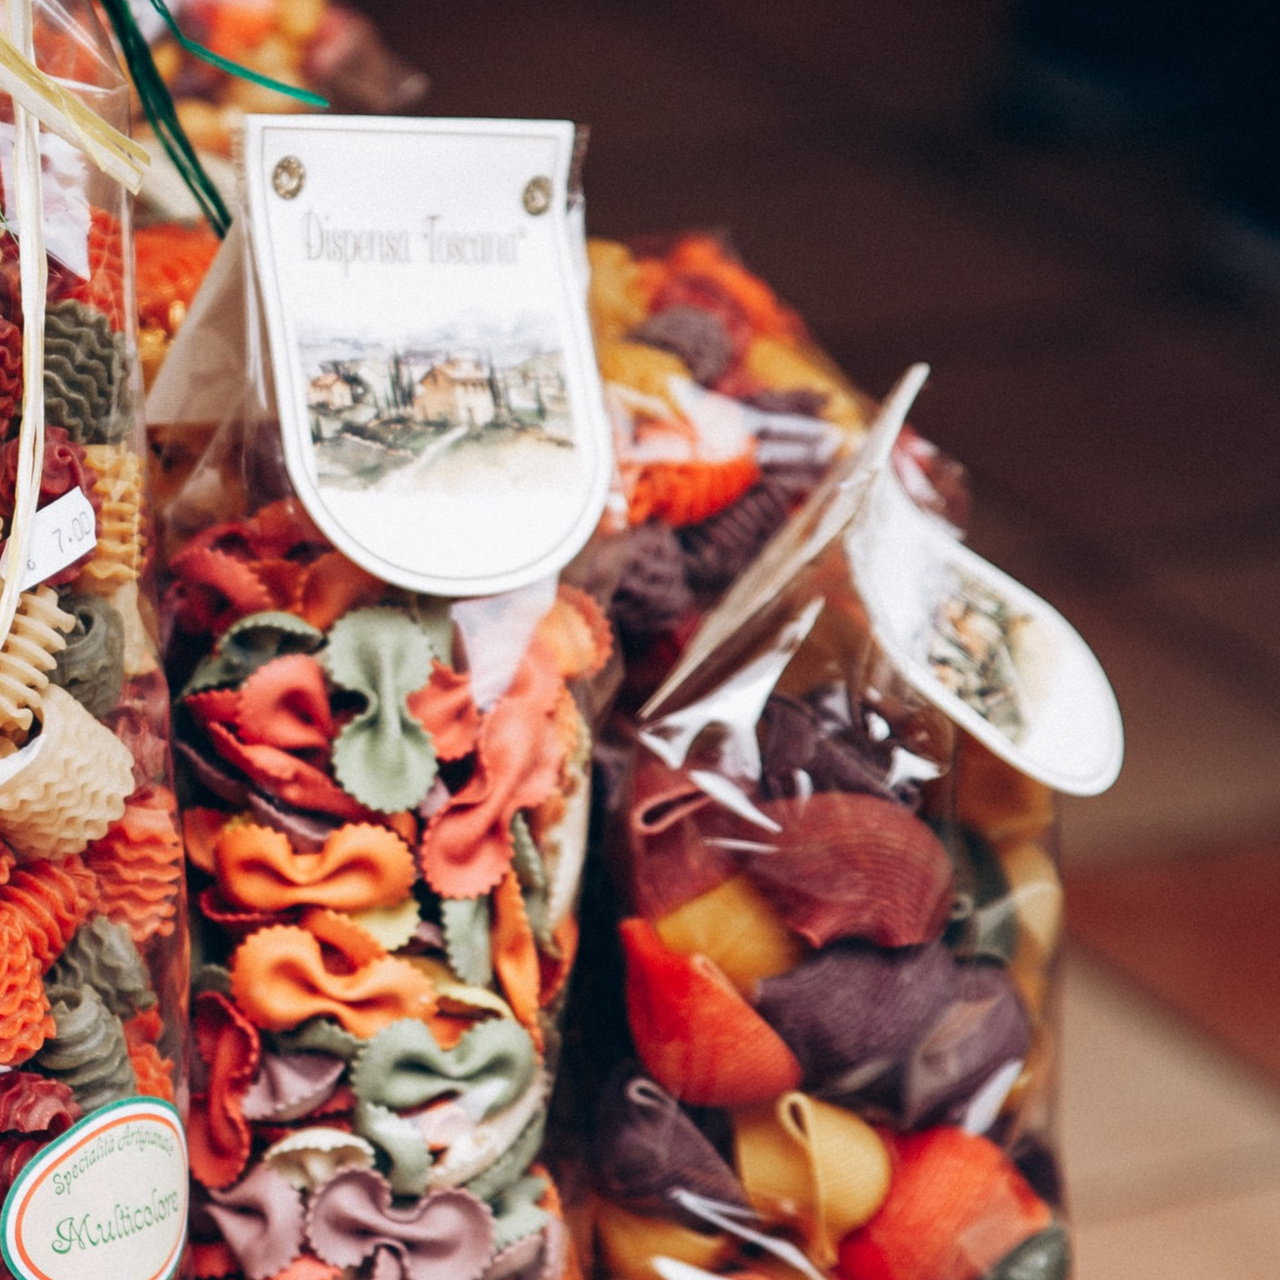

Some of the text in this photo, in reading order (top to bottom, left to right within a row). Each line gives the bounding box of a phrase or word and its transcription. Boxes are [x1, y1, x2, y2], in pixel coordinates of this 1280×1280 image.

[302, 210, 412, 279] Dispensa
[52, 510, 92, 554] 7.00
[51, 1187, 179, 1255] Multicolore
